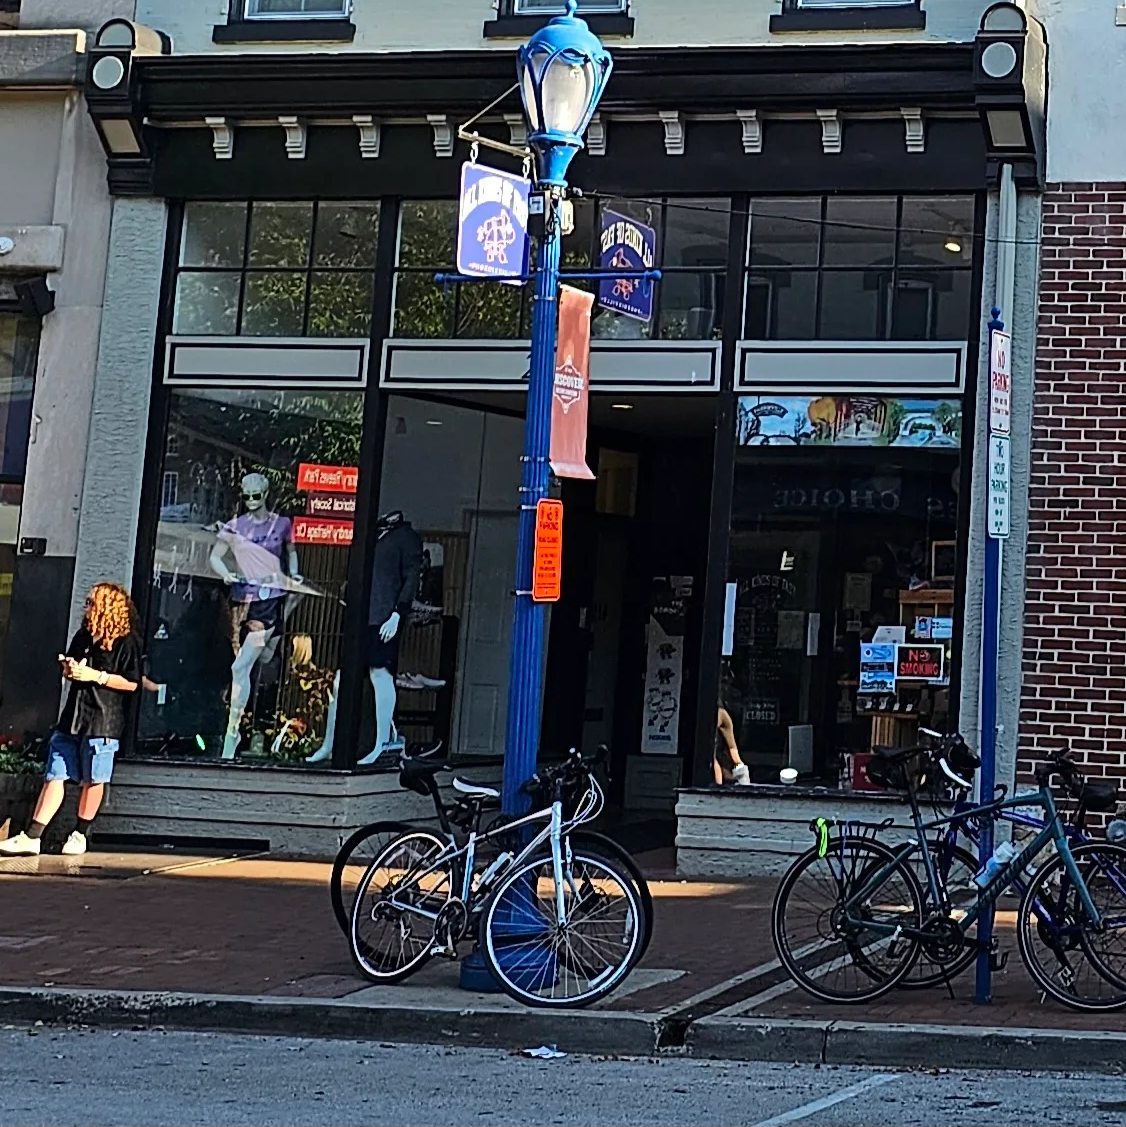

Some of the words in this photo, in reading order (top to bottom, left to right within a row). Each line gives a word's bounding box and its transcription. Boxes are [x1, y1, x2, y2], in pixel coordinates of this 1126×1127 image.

[997, 349, 1006, 369] NO
[992, 371, 1010, 393] PARKING
[899, 662, 939, 675] SMOKING
[745, 710, 777, 721] CLOSED
